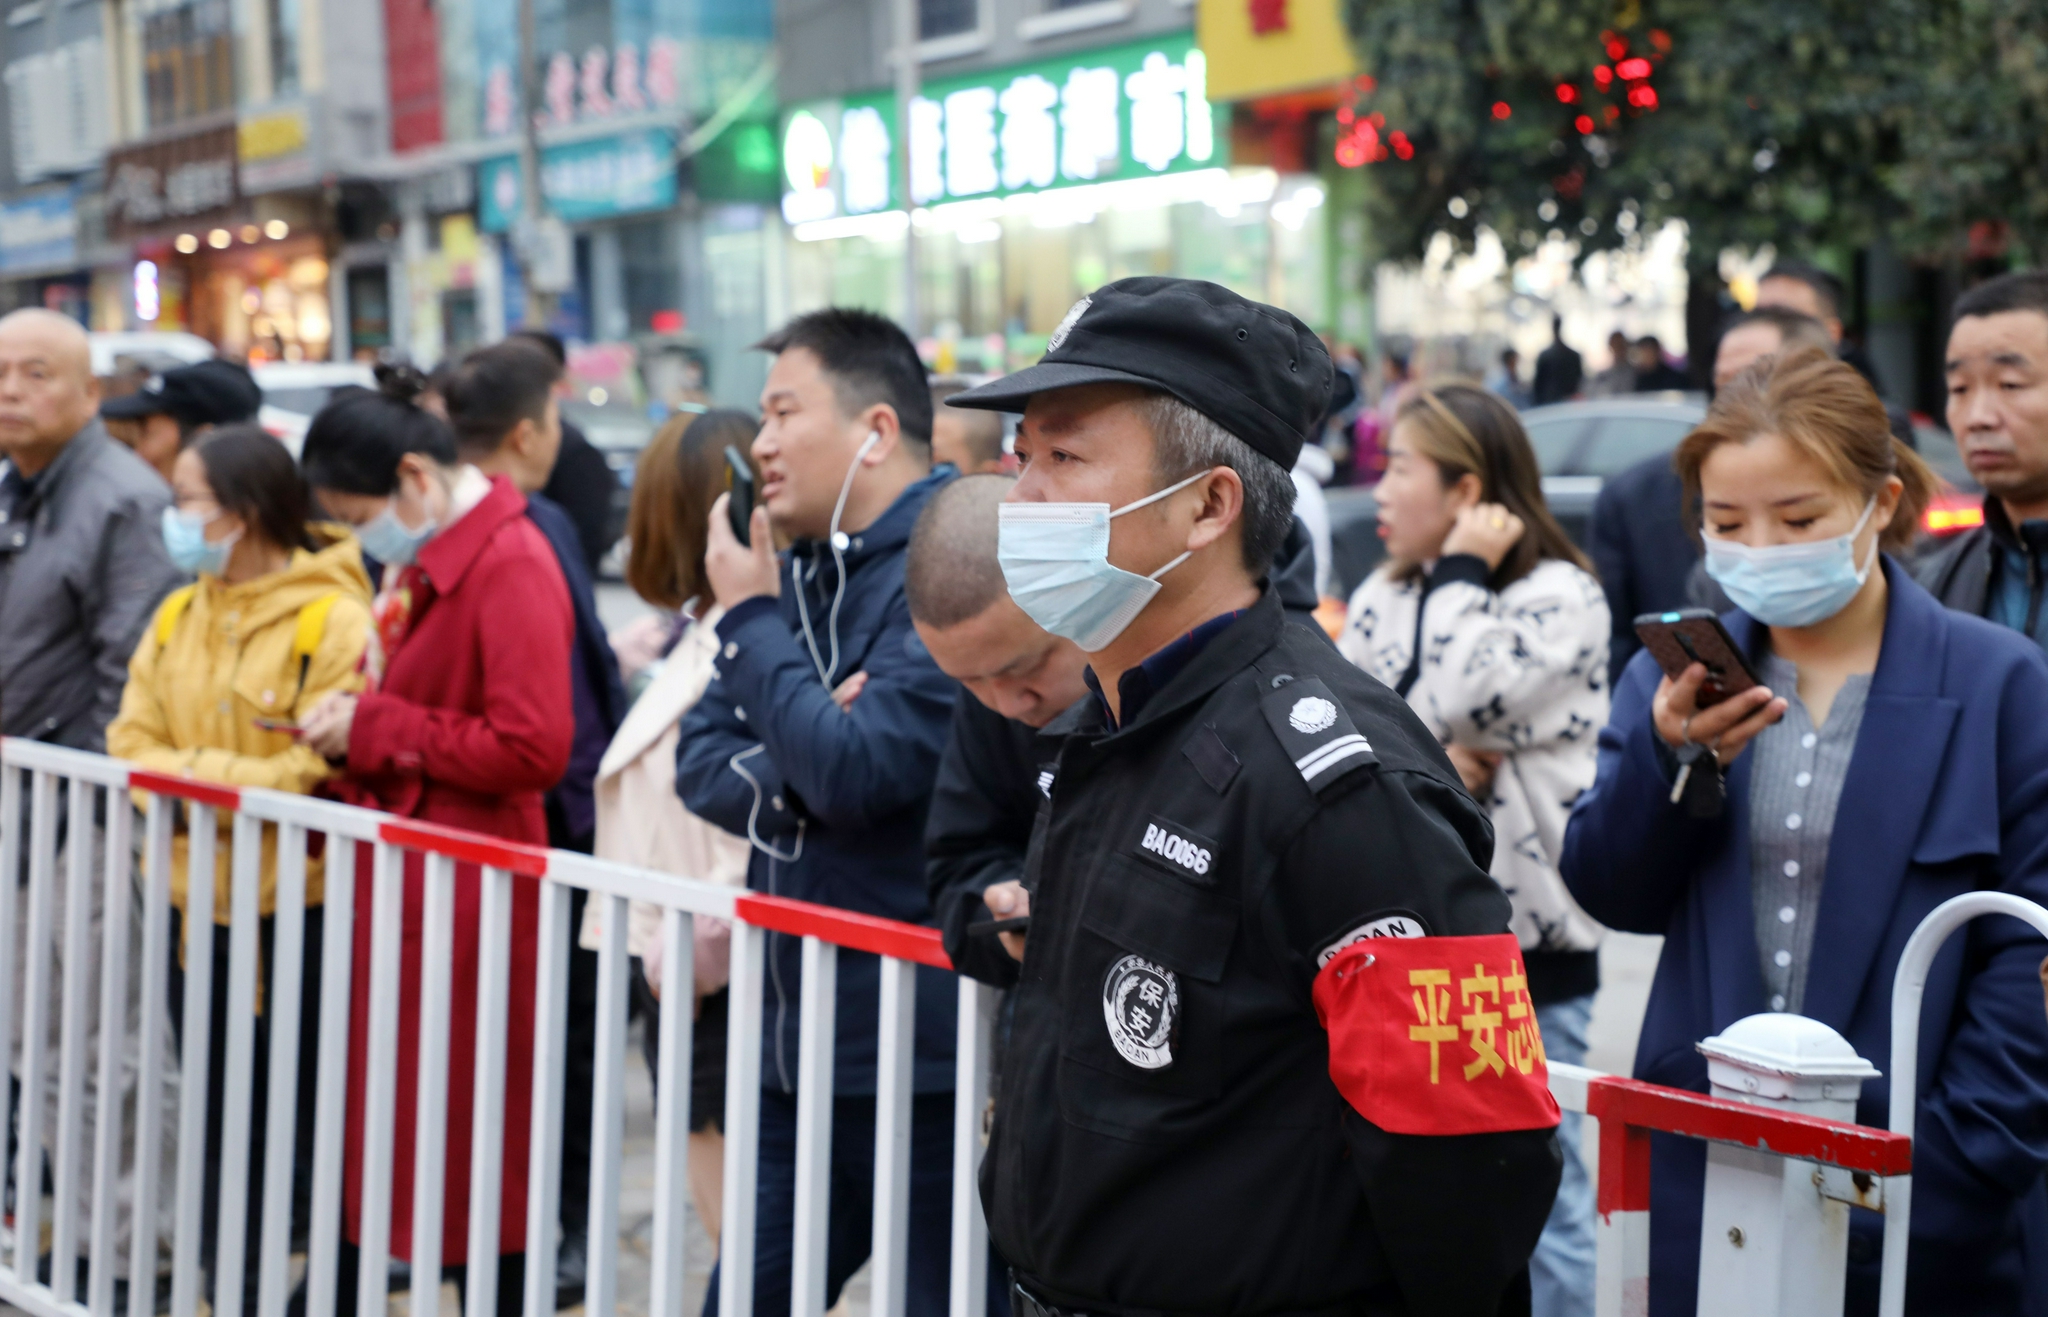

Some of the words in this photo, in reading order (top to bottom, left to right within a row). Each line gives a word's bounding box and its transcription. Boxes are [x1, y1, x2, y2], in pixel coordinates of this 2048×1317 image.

[1324, 919, 1408, 961] OAN
[1128, 977, 1165, 1037] 保安
[1409, 958, 1546, 1085] 平安志
[1114, 1029, 1151, 1064] BAOAN
